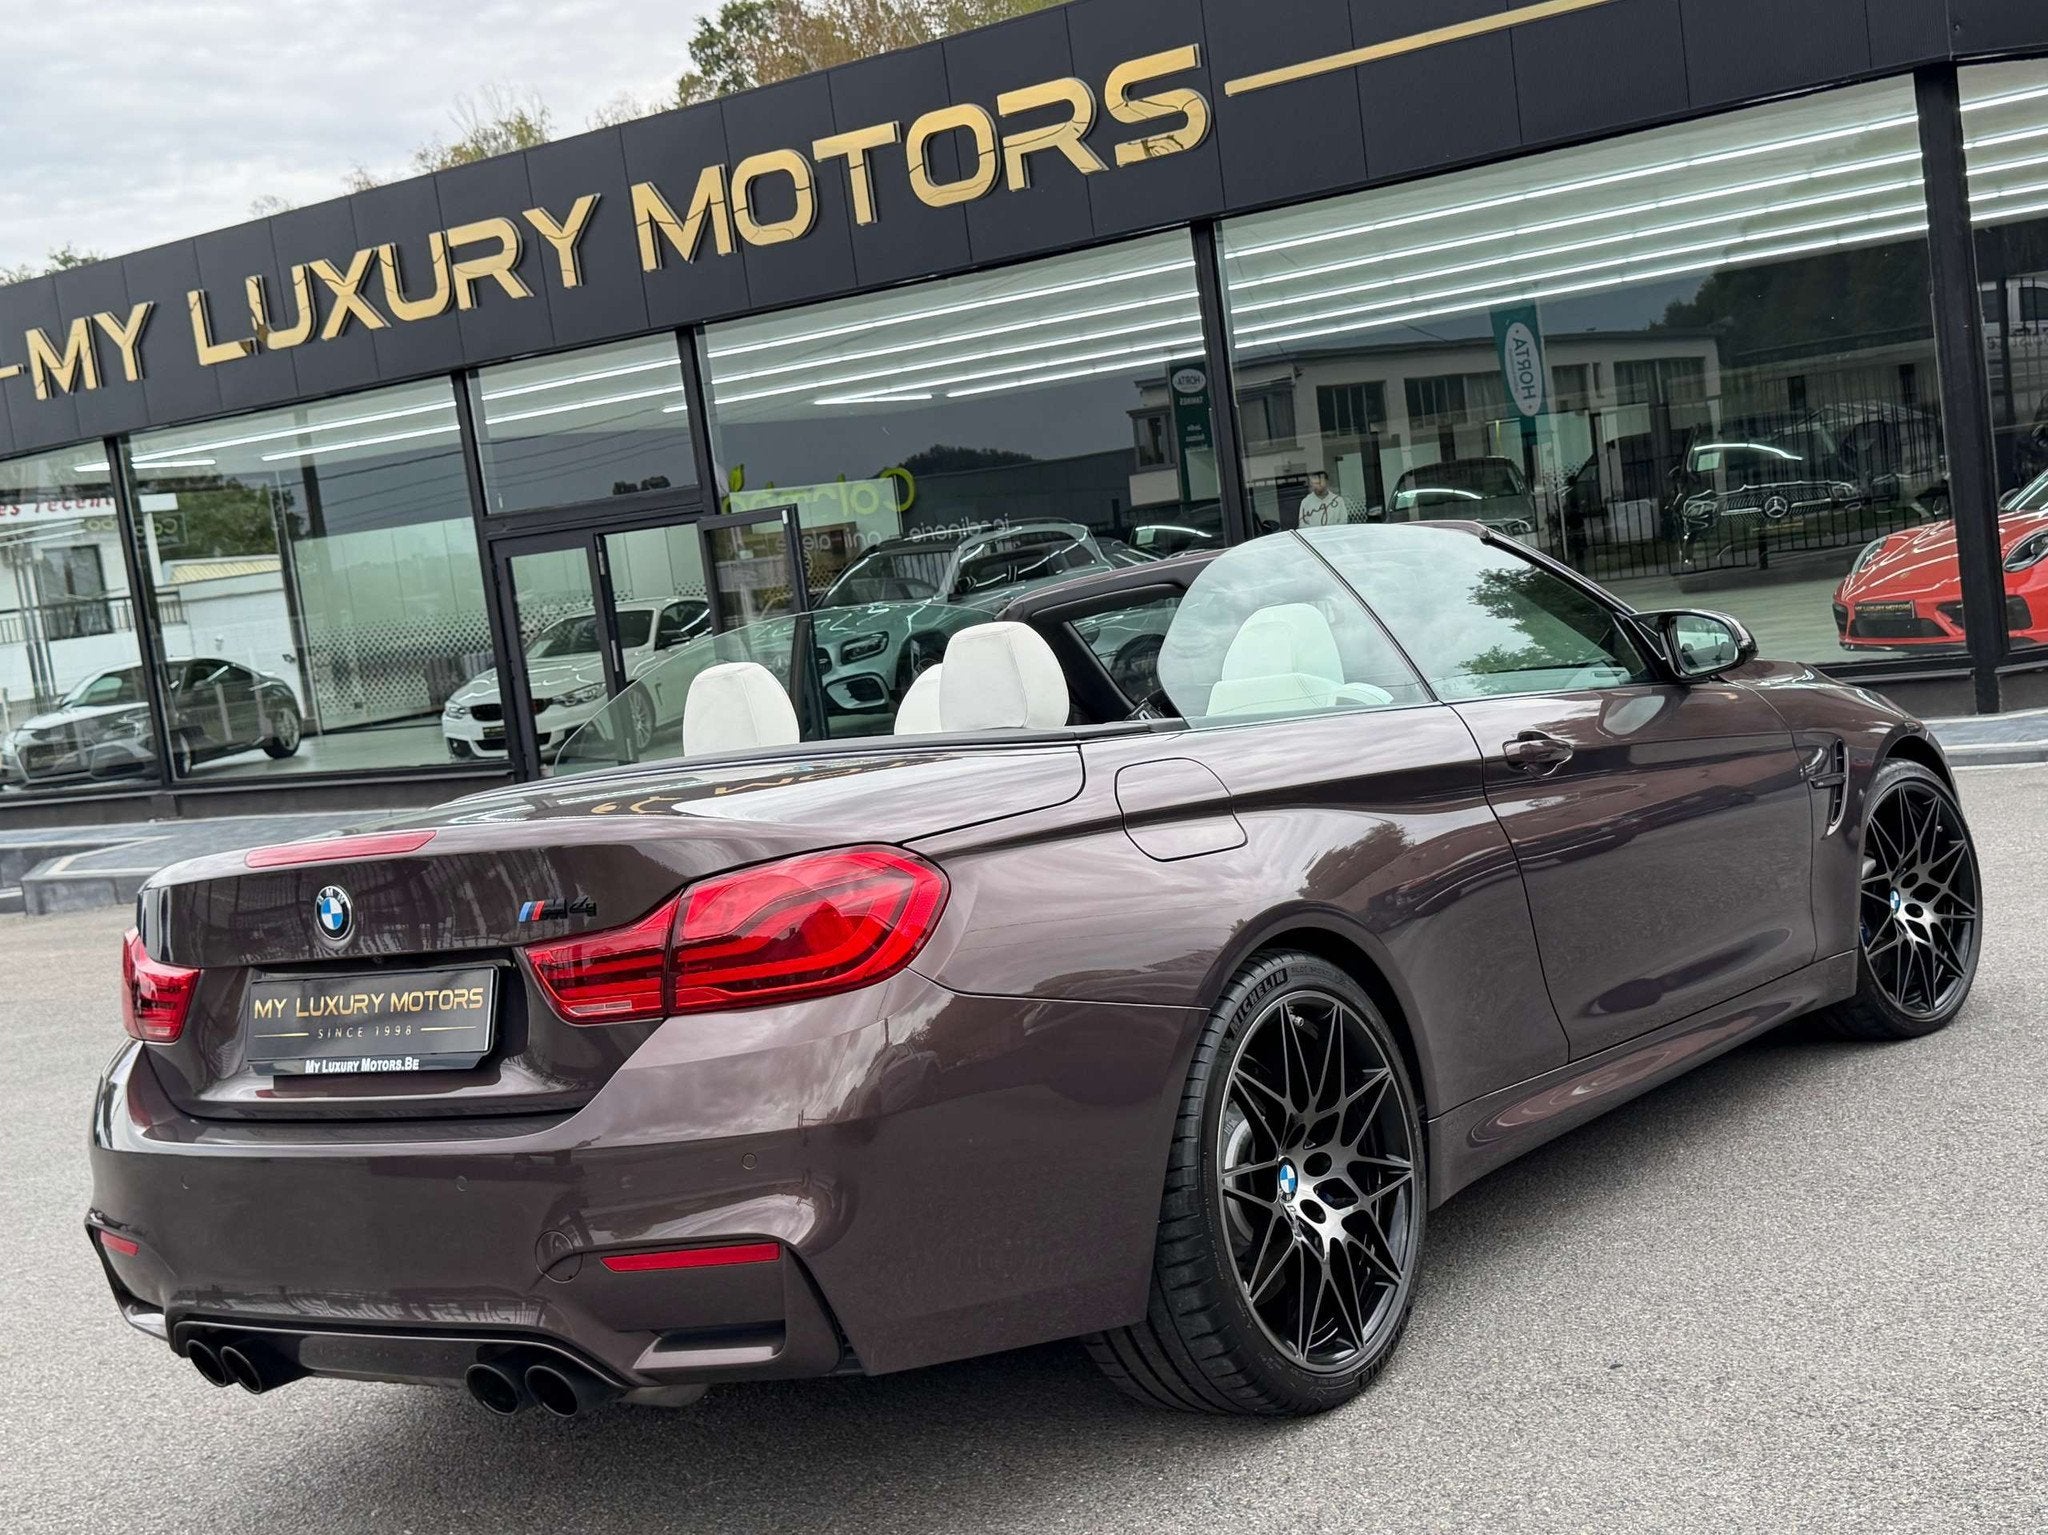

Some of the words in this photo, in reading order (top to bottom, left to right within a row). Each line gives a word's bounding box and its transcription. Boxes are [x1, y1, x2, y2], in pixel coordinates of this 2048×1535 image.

[26, 300, 154, 401] MY
[187, 192, 600, 367] LUXURY
[630, 43, 1212, 272] MOTORS
[254, 998, 288, 1019] MY
[295, 993, 385, 1017] LUXURY
[390, 987, 484, 1013] MOTORS
[1230, 968, 1287, 1036] MICHELIN
[317, 1027, 364, 1039] SINCE
[375, 1025, 412, 1037] 1998
